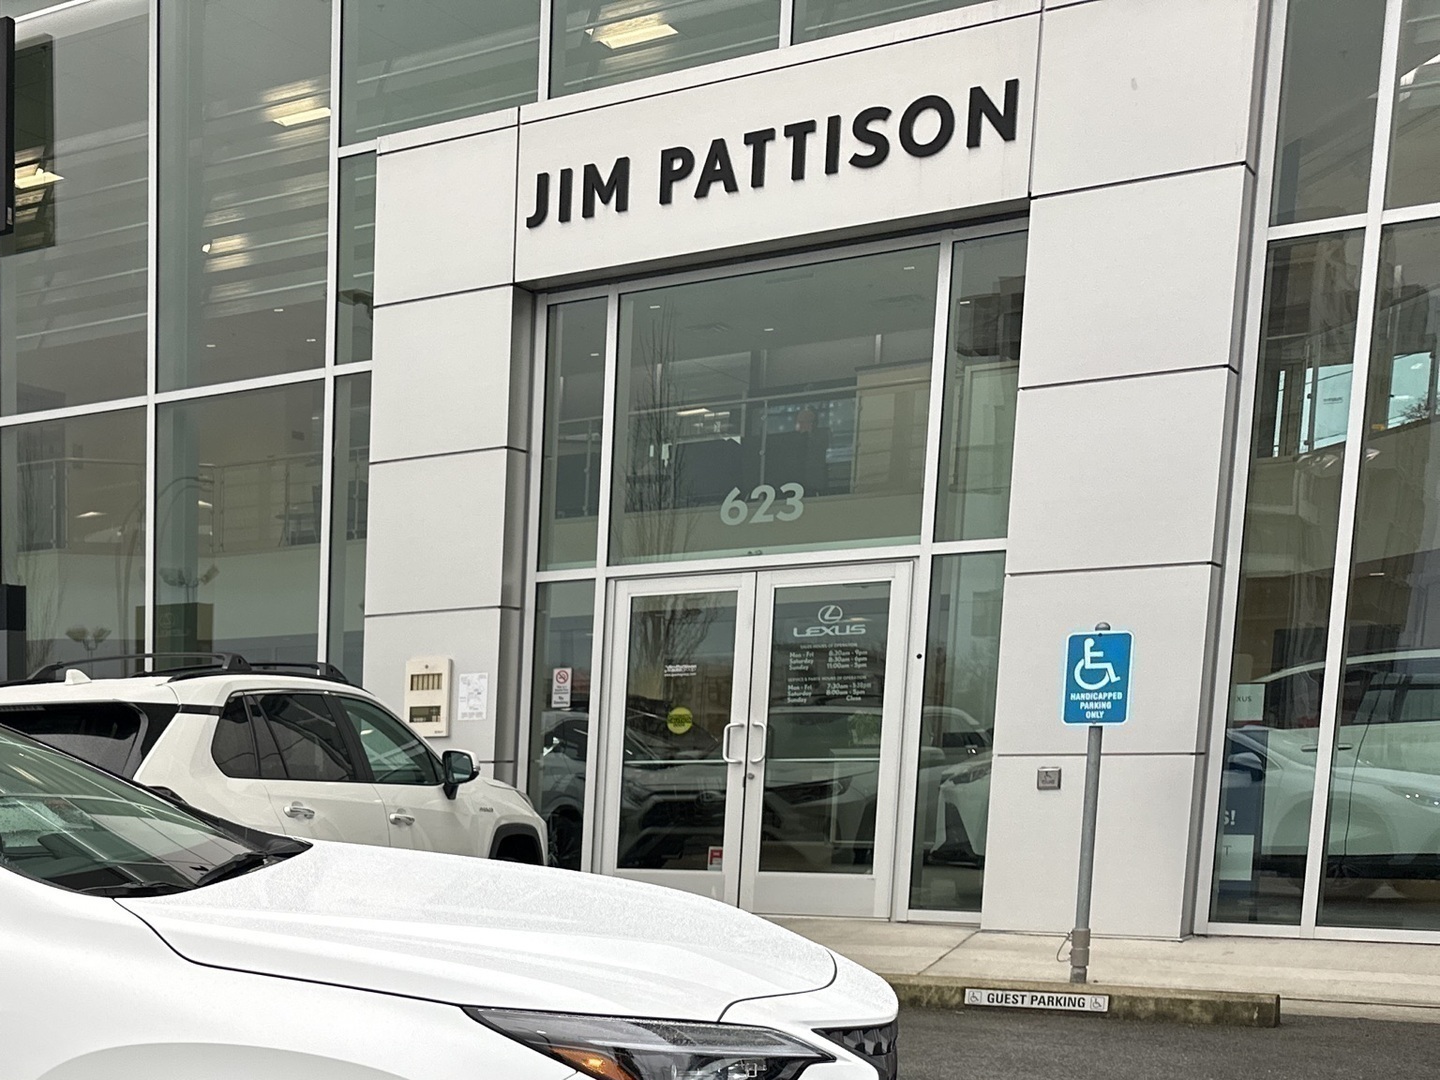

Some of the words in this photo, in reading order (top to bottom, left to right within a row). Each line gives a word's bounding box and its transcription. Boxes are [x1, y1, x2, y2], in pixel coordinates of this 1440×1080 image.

[526, 156, 630, 229] JIM
[659, 78, 1020, 205] PATTISON
[720, 482, 805, 526] 623
[793, 624, 866, 637] LEXUS
[1070, 692, 1123, 700] HANDICAPPED
[1080, 701, 1112, 709] PARKING
[1085, 710, 1105, 719] ONLY
[987, 993, 1027, 1005] GUEST
[1030, 994, 1086, 1008] PARKING
